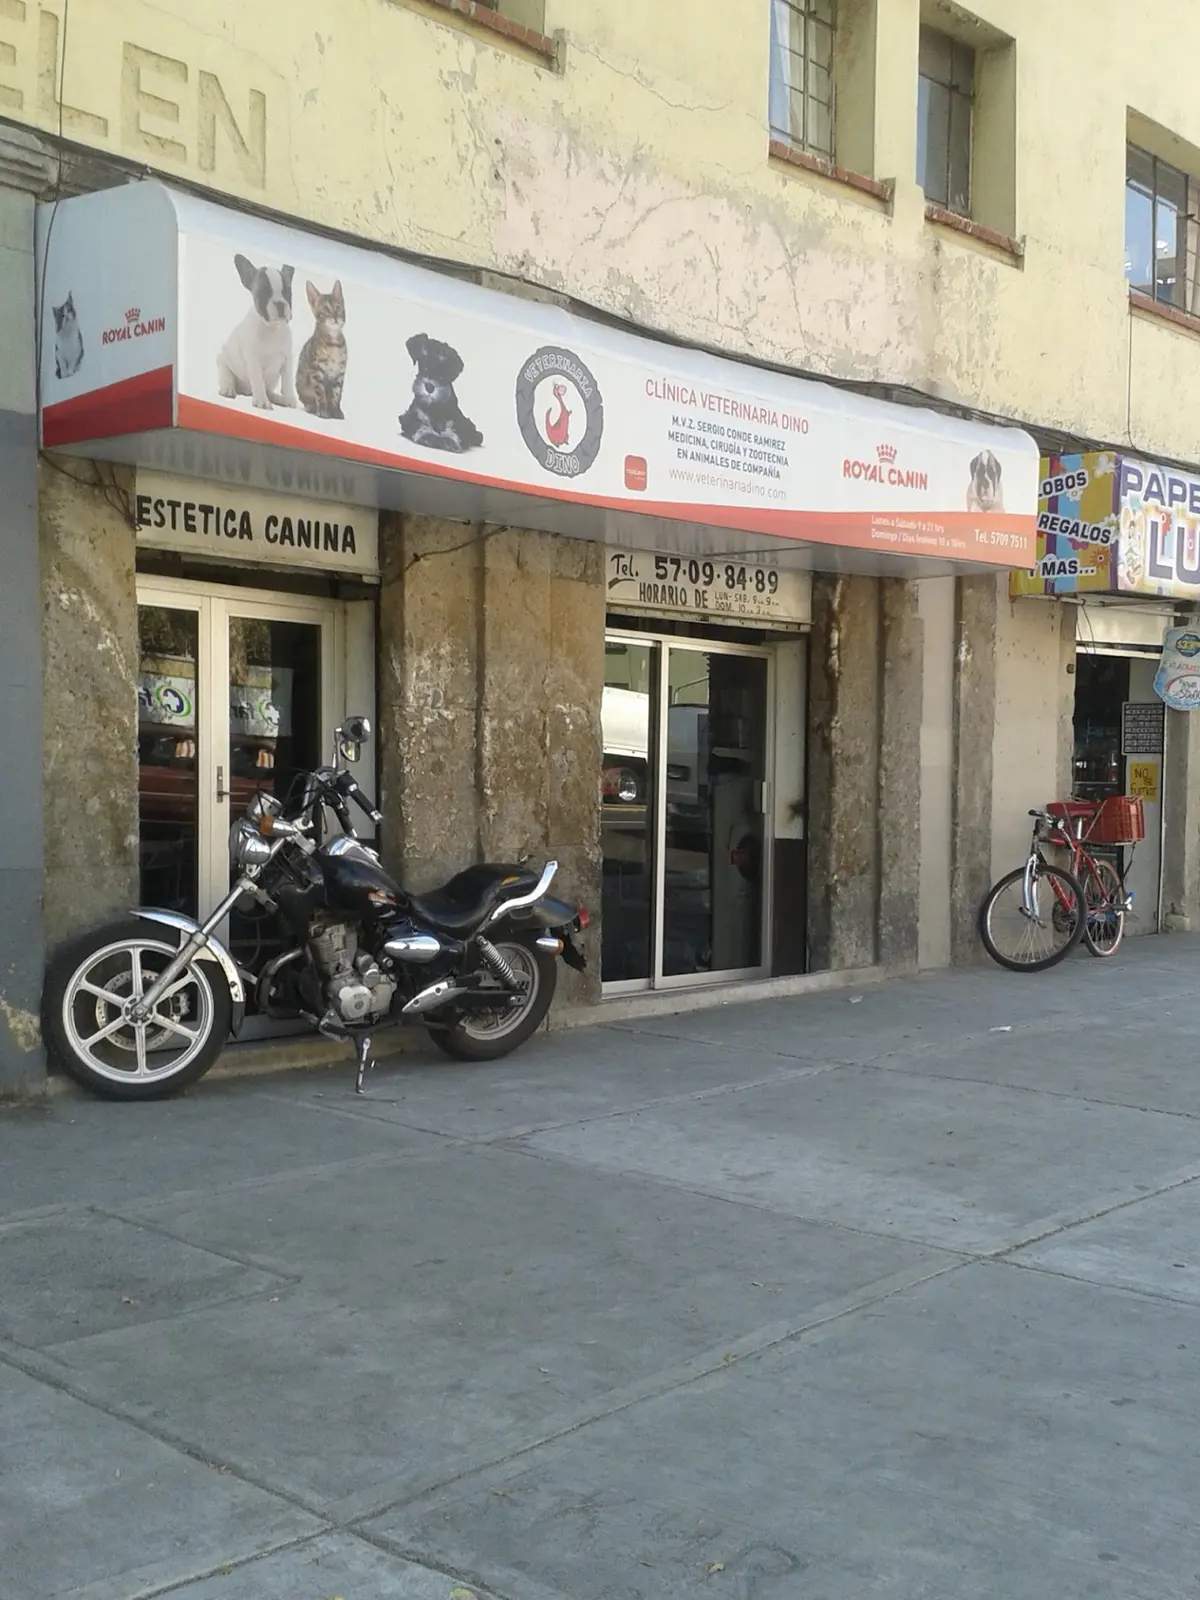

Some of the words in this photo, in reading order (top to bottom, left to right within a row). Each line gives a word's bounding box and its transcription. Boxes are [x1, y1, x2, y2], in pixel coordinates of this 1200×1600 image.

[102, 326, 132, 345] ROYAL
[134, 317, 165, 337] CANIN
[523, 353, 593, 399] VETERINARIA
[645, 377, 698, 407] CLÍNICA
[700, 391, 779, 427] VETERINARIA
[782, 414, 809, 435] DINO
[697, 420, 726, 437] SERGIO
[727, 428, 752, 443] CONDE
[753, 435, 786, 451] RAMIREZ
[545, 449, 580, 474] DINO
[677, 448, 688, 460] EN
[689, 450, 730, 469] ANIMALES
[731, 459, 741, 471] DE
[749, 448, 789, 467] ZOOTECNIA
[669, 467, 787, 501] www.veterinariadino.com
[843, 459, 885, 484] ROYAL
[888, 468, 928, 491] CANIN
[136, 494, 253, 541] ESTETICA
[265, 515, 356, 554] CANINA
[1038, 514, 1112, 544] REGALOS
[610, 553, 640, 577] Tel.
[639, 582, 688, 606] HORARIO
[694, 589, 709, 609] DE
